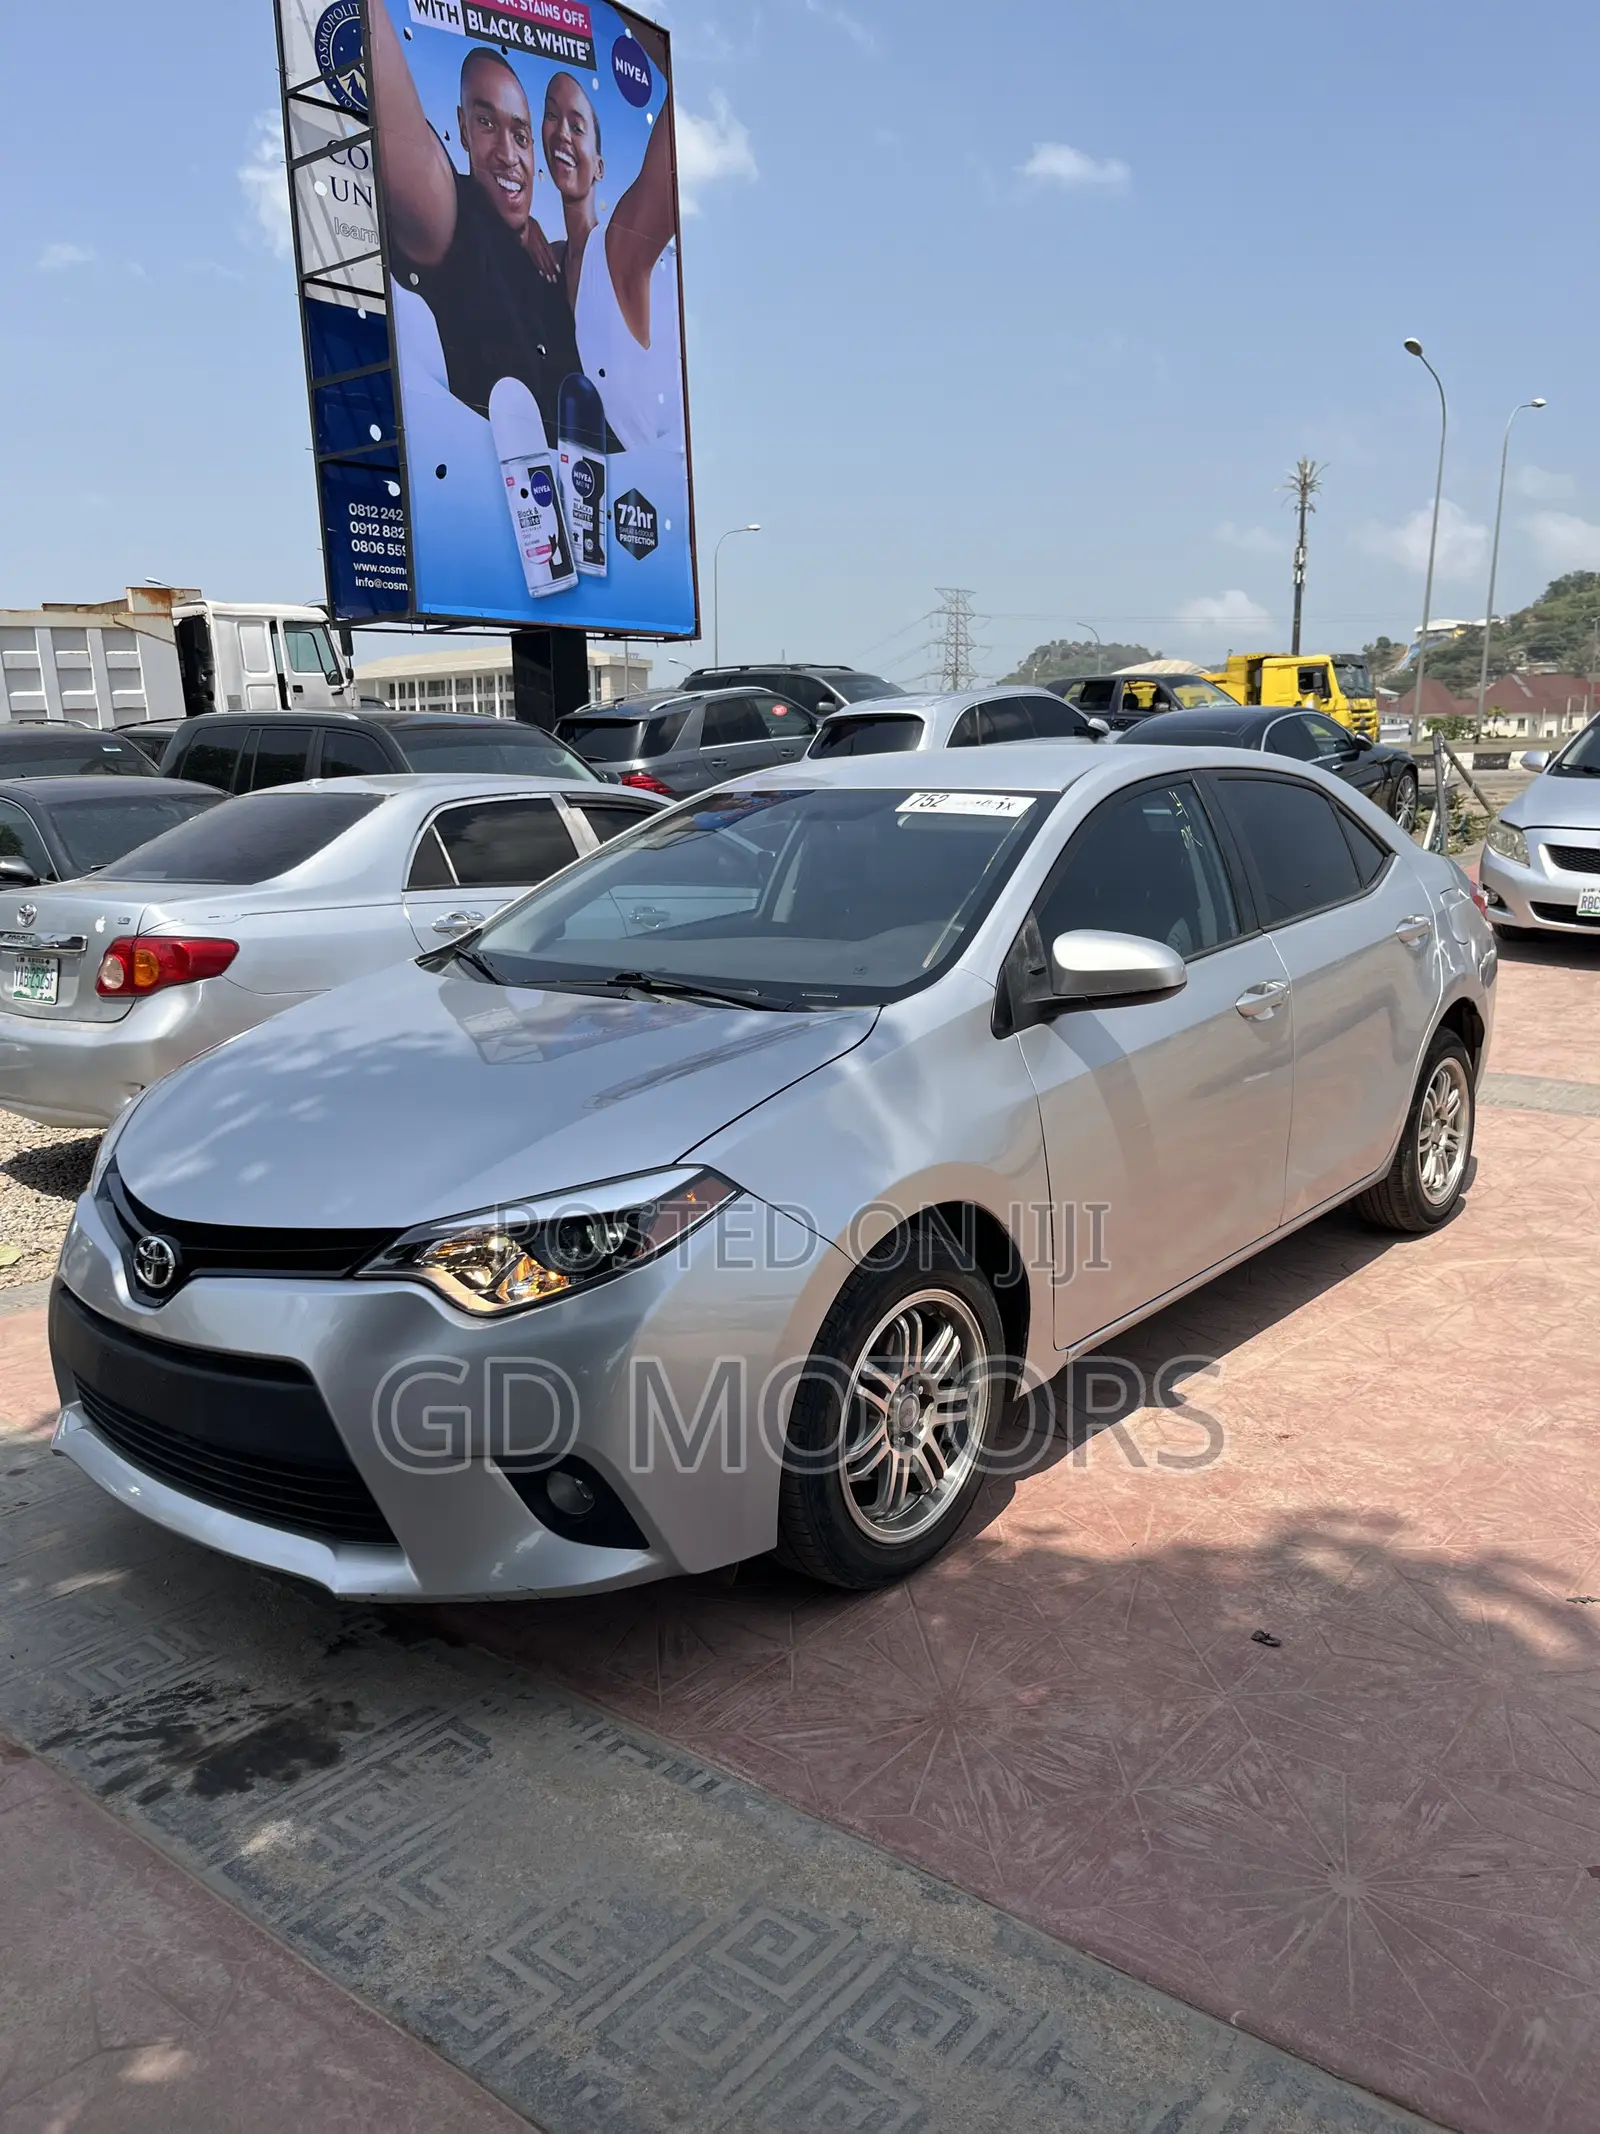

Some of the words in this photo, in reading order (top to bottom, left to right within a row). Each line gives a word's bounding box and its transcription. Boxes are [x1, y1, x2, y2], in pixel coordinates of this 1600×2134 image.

[414, 0, 460, 25] WITH
[466, 9, 522, 43] BLACK
[523, 25, 537, 47] &
[520, 0, 561, 21] STAINS
[562, 8, 589, 30] OFF.
[319, 3, 360, 76] OSMOPOLIT
[615, 56, 649, 86] NIVEA
[334, 217, 379, 245] learn
[573, 470, 592, 483] NIVEA
[533, 485, 551, 495] NIVEA
[348, 503, 379, 518] 0812
[380, 507, 404, 521] 242
[618, 503, 654, 529] 72hr
[350, 521, 380, 536] 0912
[351, 539, 385, 555] 0806
[620, 534, 655, 546] PROTECTION
[909, 794, 950, 808] 752
